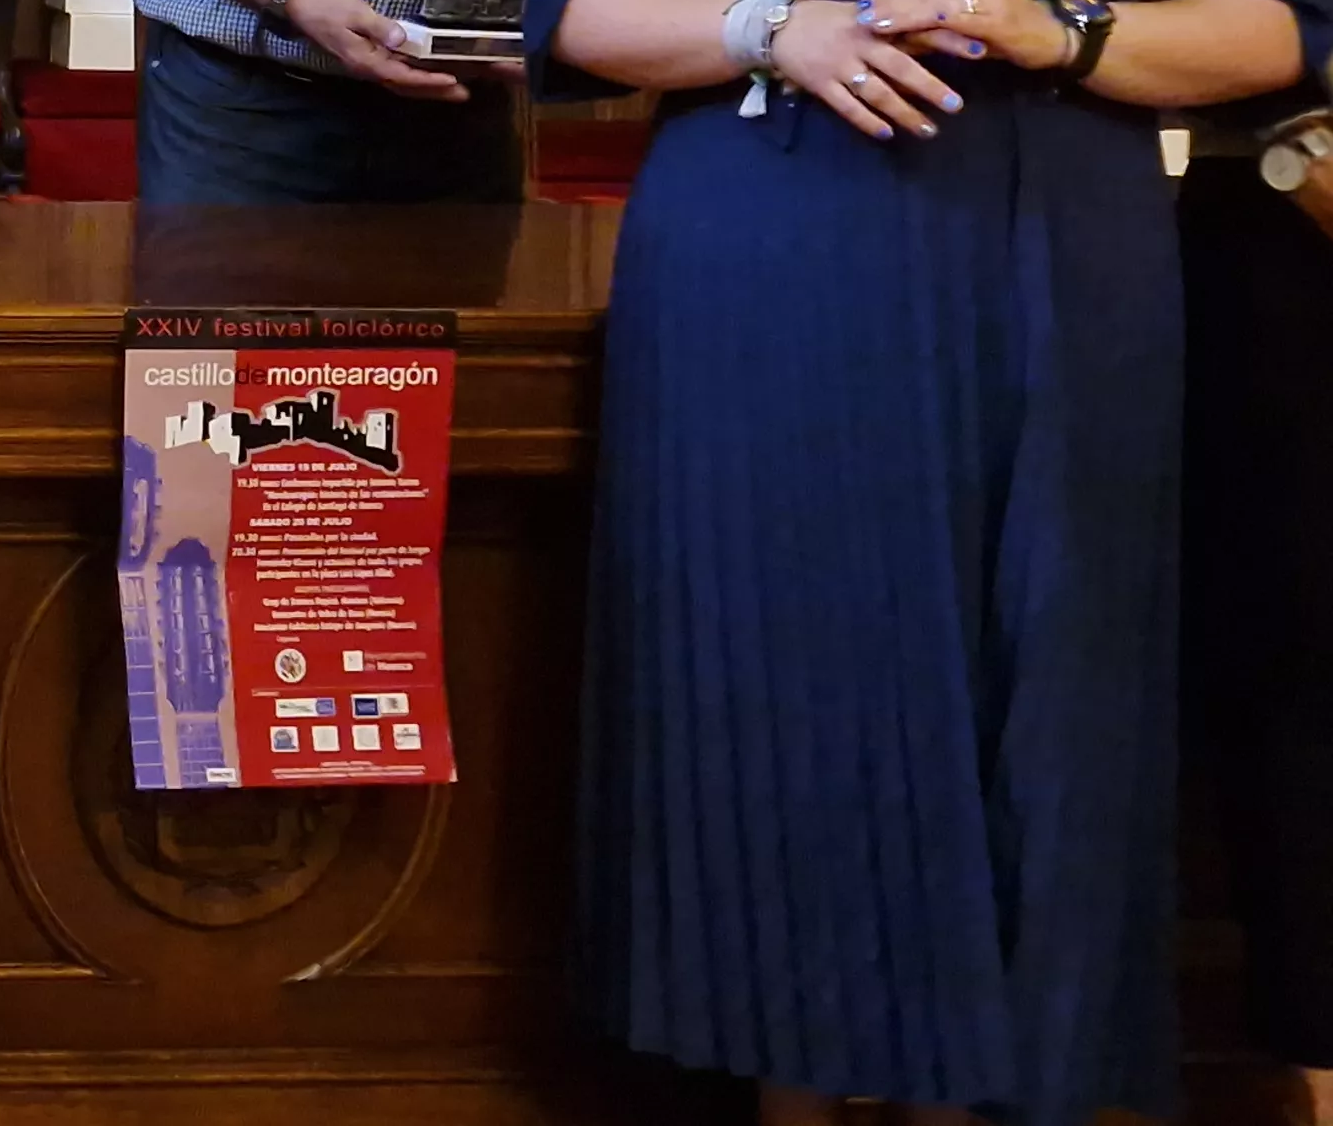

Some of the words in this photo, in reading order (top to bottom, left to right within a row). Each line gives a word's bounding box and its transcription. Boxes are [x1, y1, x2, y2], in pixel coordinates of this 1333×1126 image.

[136, 317, 203, 337] XXIV
[213, 317, 311, 337] festival
[323, 316, 446, 338] folclórico
